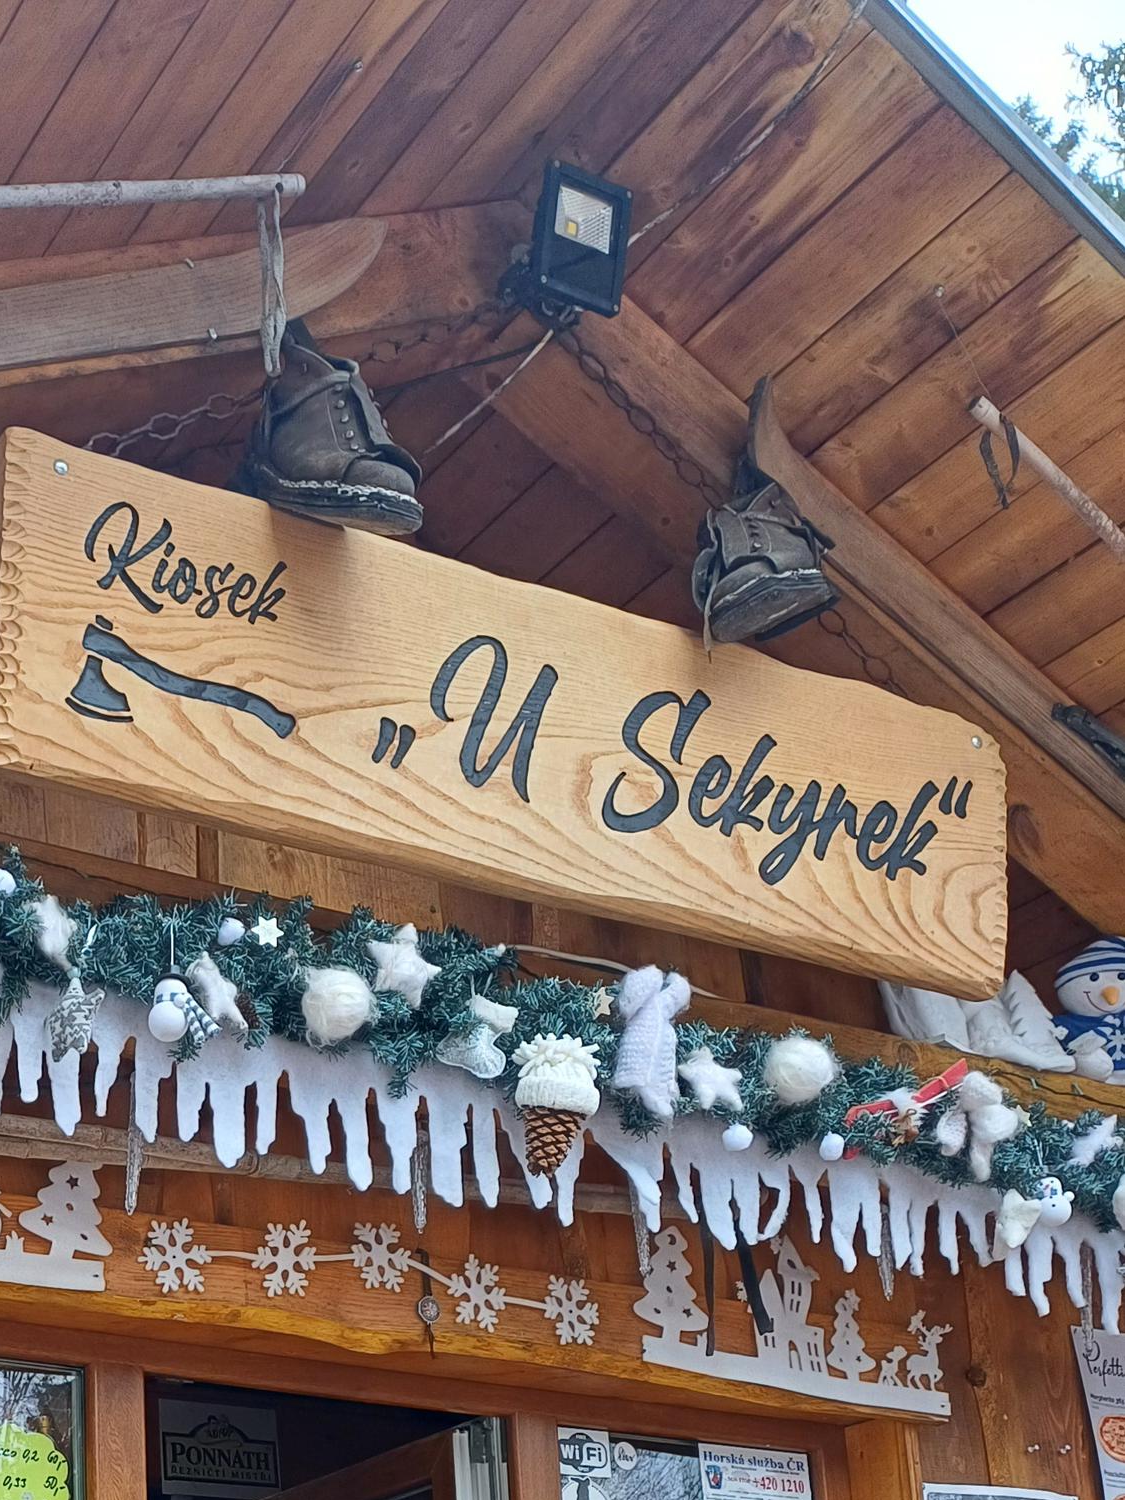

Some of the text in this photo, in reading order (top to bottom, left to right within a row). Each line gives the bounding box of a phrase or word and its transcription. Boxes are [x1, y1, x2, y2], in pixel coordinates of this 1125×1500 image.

[84, 501, 286, 624] Kiosek
[22, 1448, 40, 1463] 0,2
[171, 1442, 271, 1471] PONNATH
[702, 1450, 806, 1472] Horská služba ČR
[2, 1475, 27, 1490] 0,33
[751, 1476, 806, 1494] +420 1210
